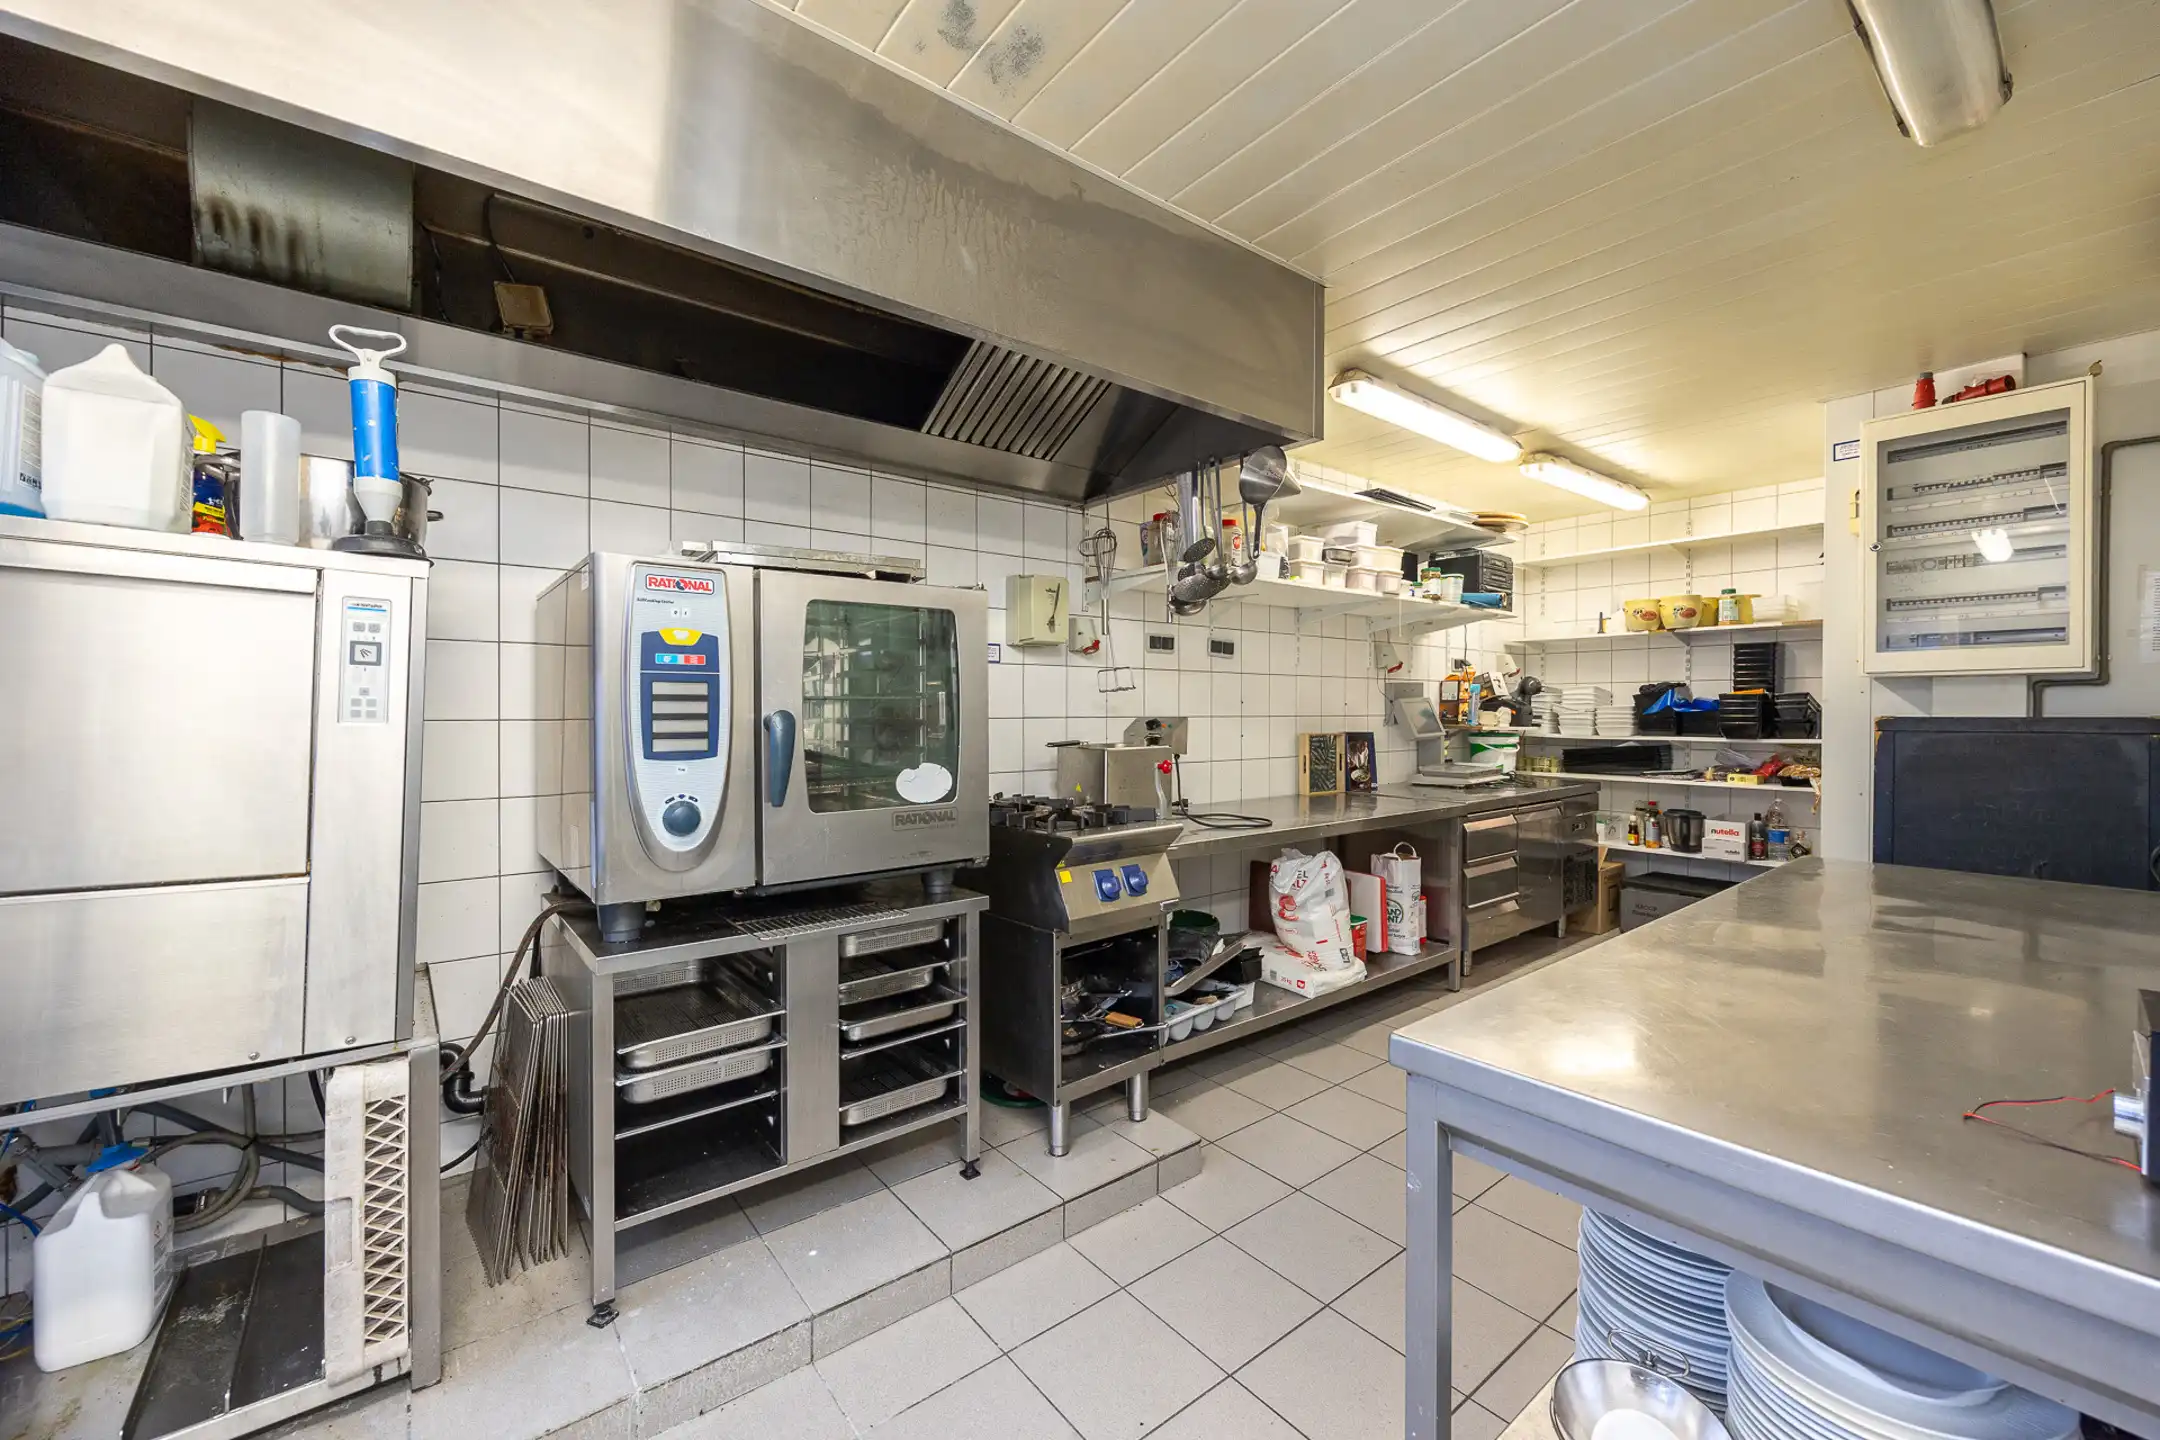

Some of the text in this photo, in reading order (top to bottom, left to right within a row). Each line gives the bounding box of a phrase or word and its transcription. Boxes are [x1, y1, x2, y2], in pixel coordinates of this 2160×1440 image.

[647, 576, 713, 593] RATIONAL
[895, 809, 956, 827] RATIONAL
[1711, 828, 1740, 837] nutella
